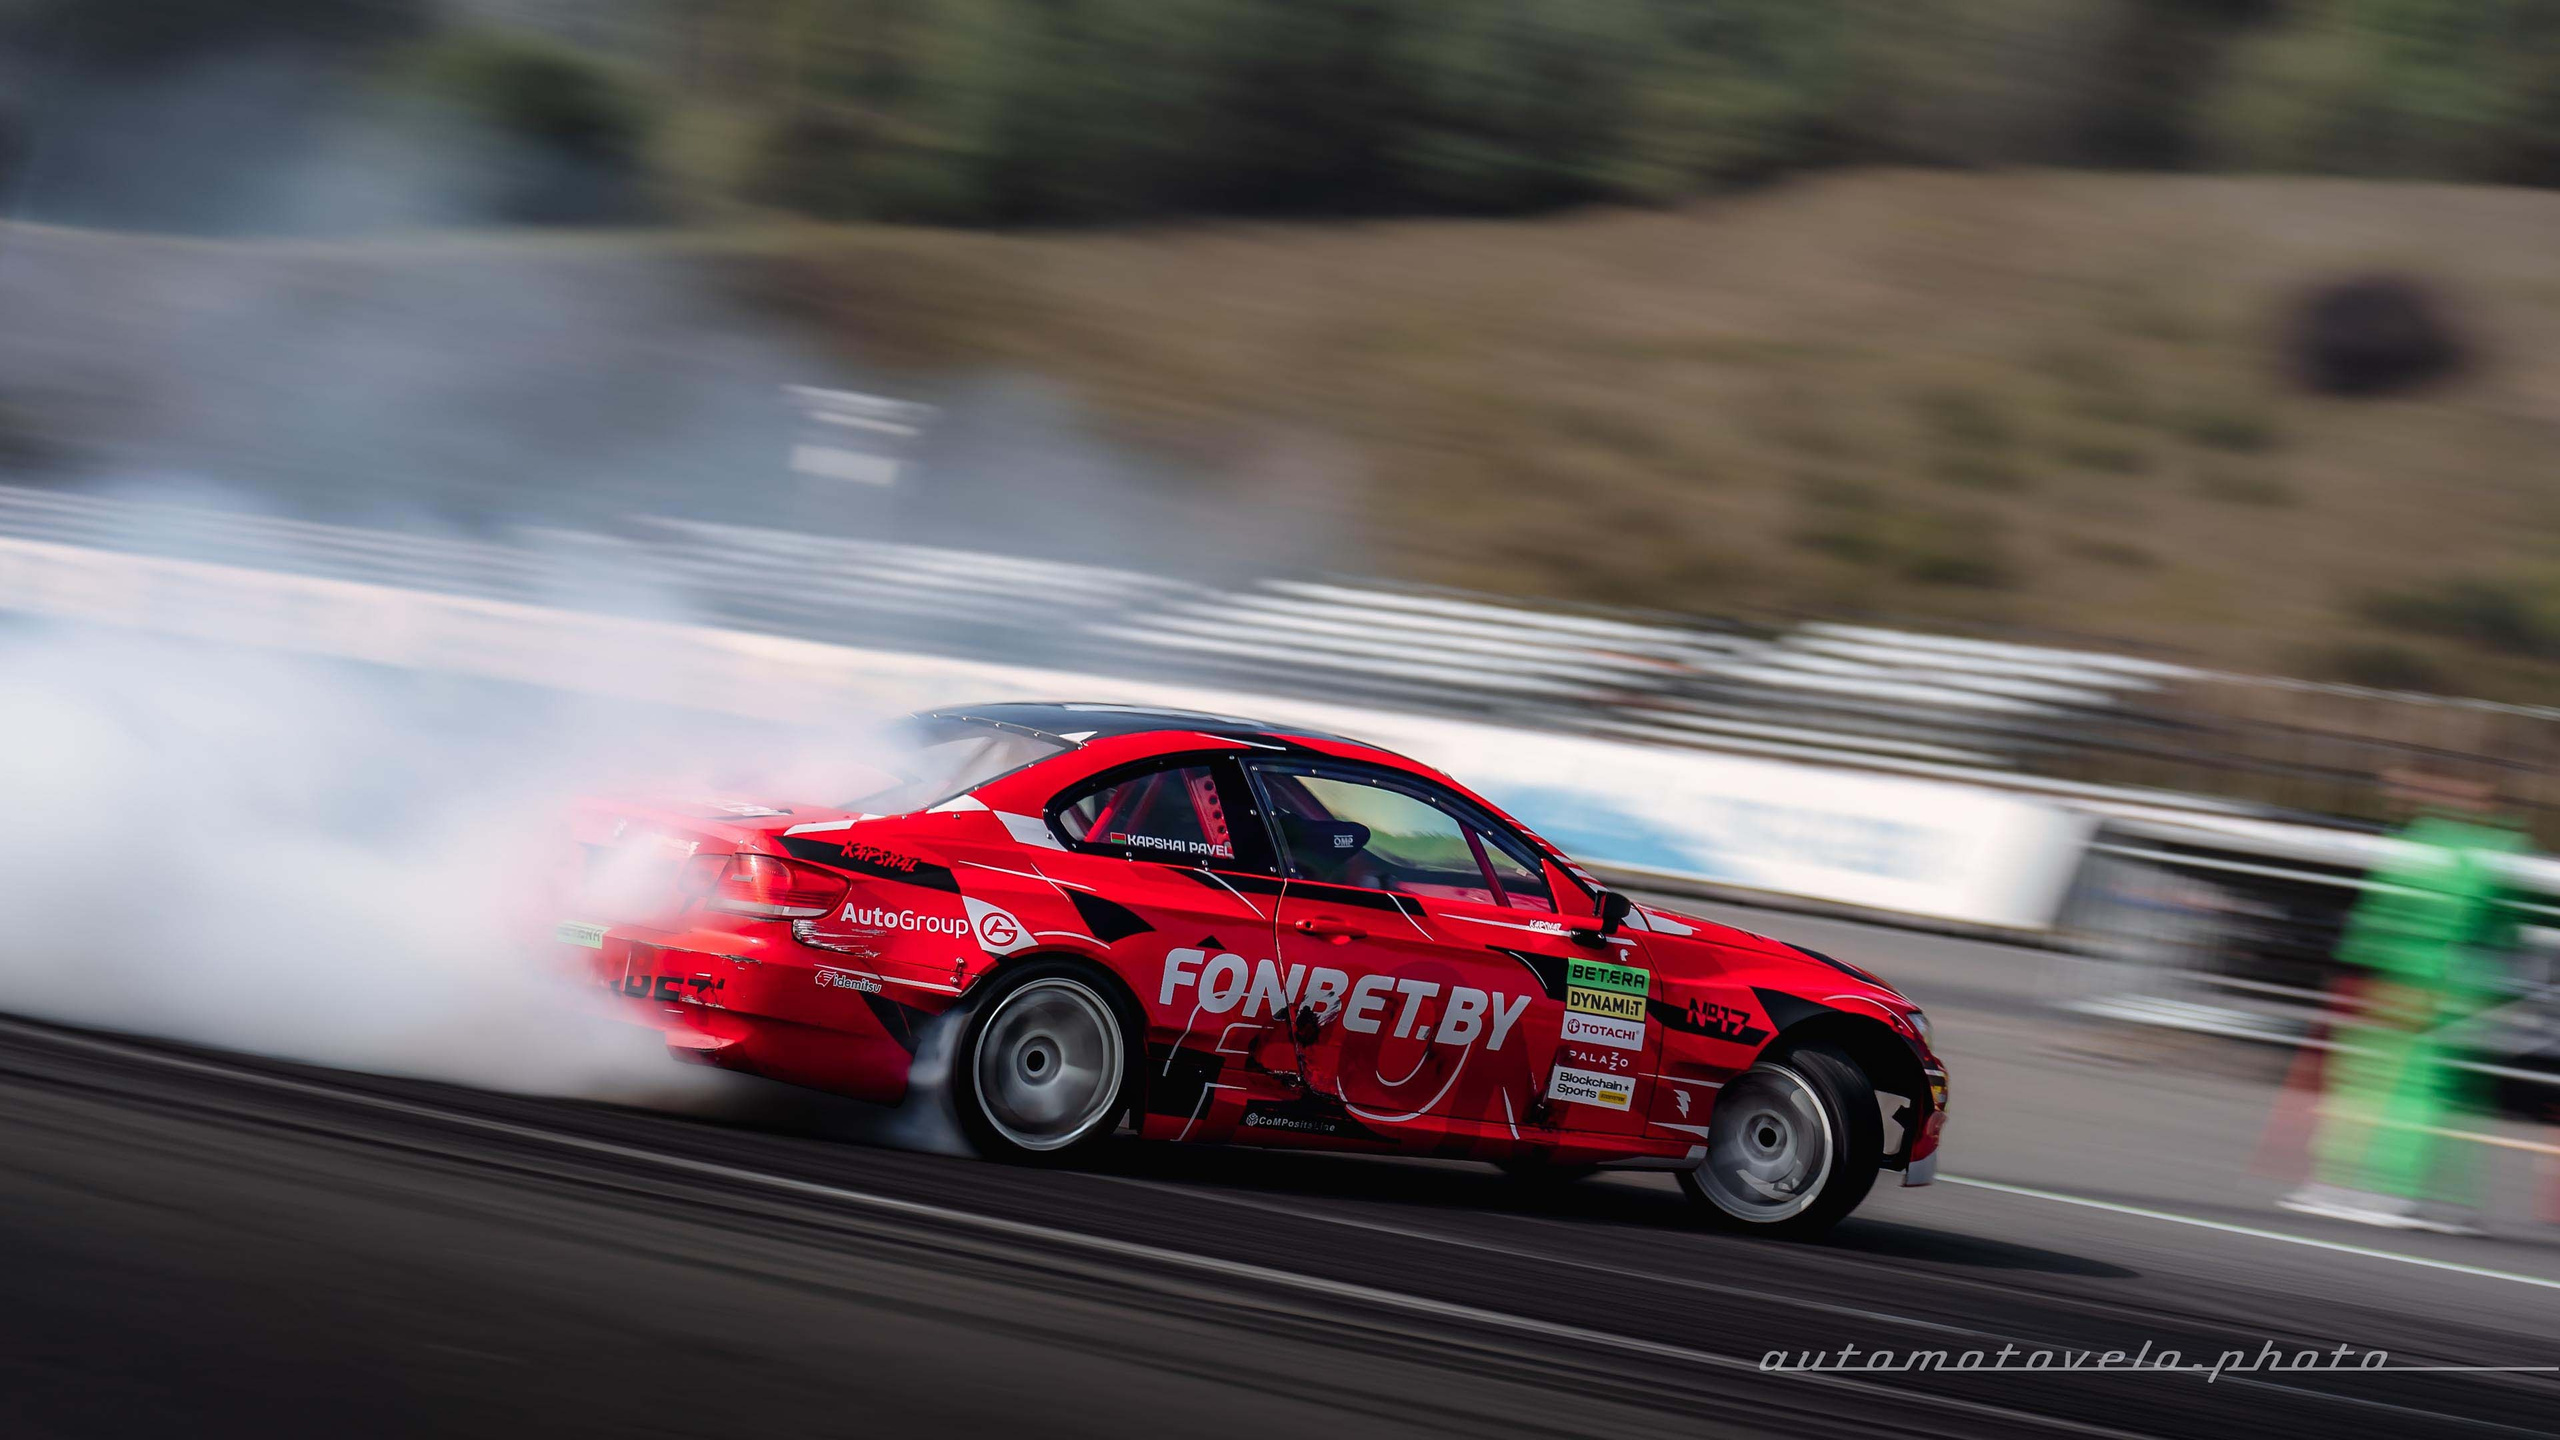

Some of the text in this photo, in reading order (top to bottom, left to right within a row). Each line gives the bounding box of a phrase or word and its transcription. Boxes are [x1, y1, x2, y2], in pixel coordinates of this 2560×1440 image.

[1127, 834, 1234, 858] KAPSHAI PAVEL
[1333, 837, 1354, 847] OMP
[840, 841, 921, 873] KAPSHAI
[840, 902, 969, 939] AutoGroup
[833, 974, 882, 993] idemitsu
[1158, 947, 1532, 1051] FONBET.BY
[1557, 1084, 1597, 1099] Sports
[1559, 1071, 1623, 1092] Blockchain
